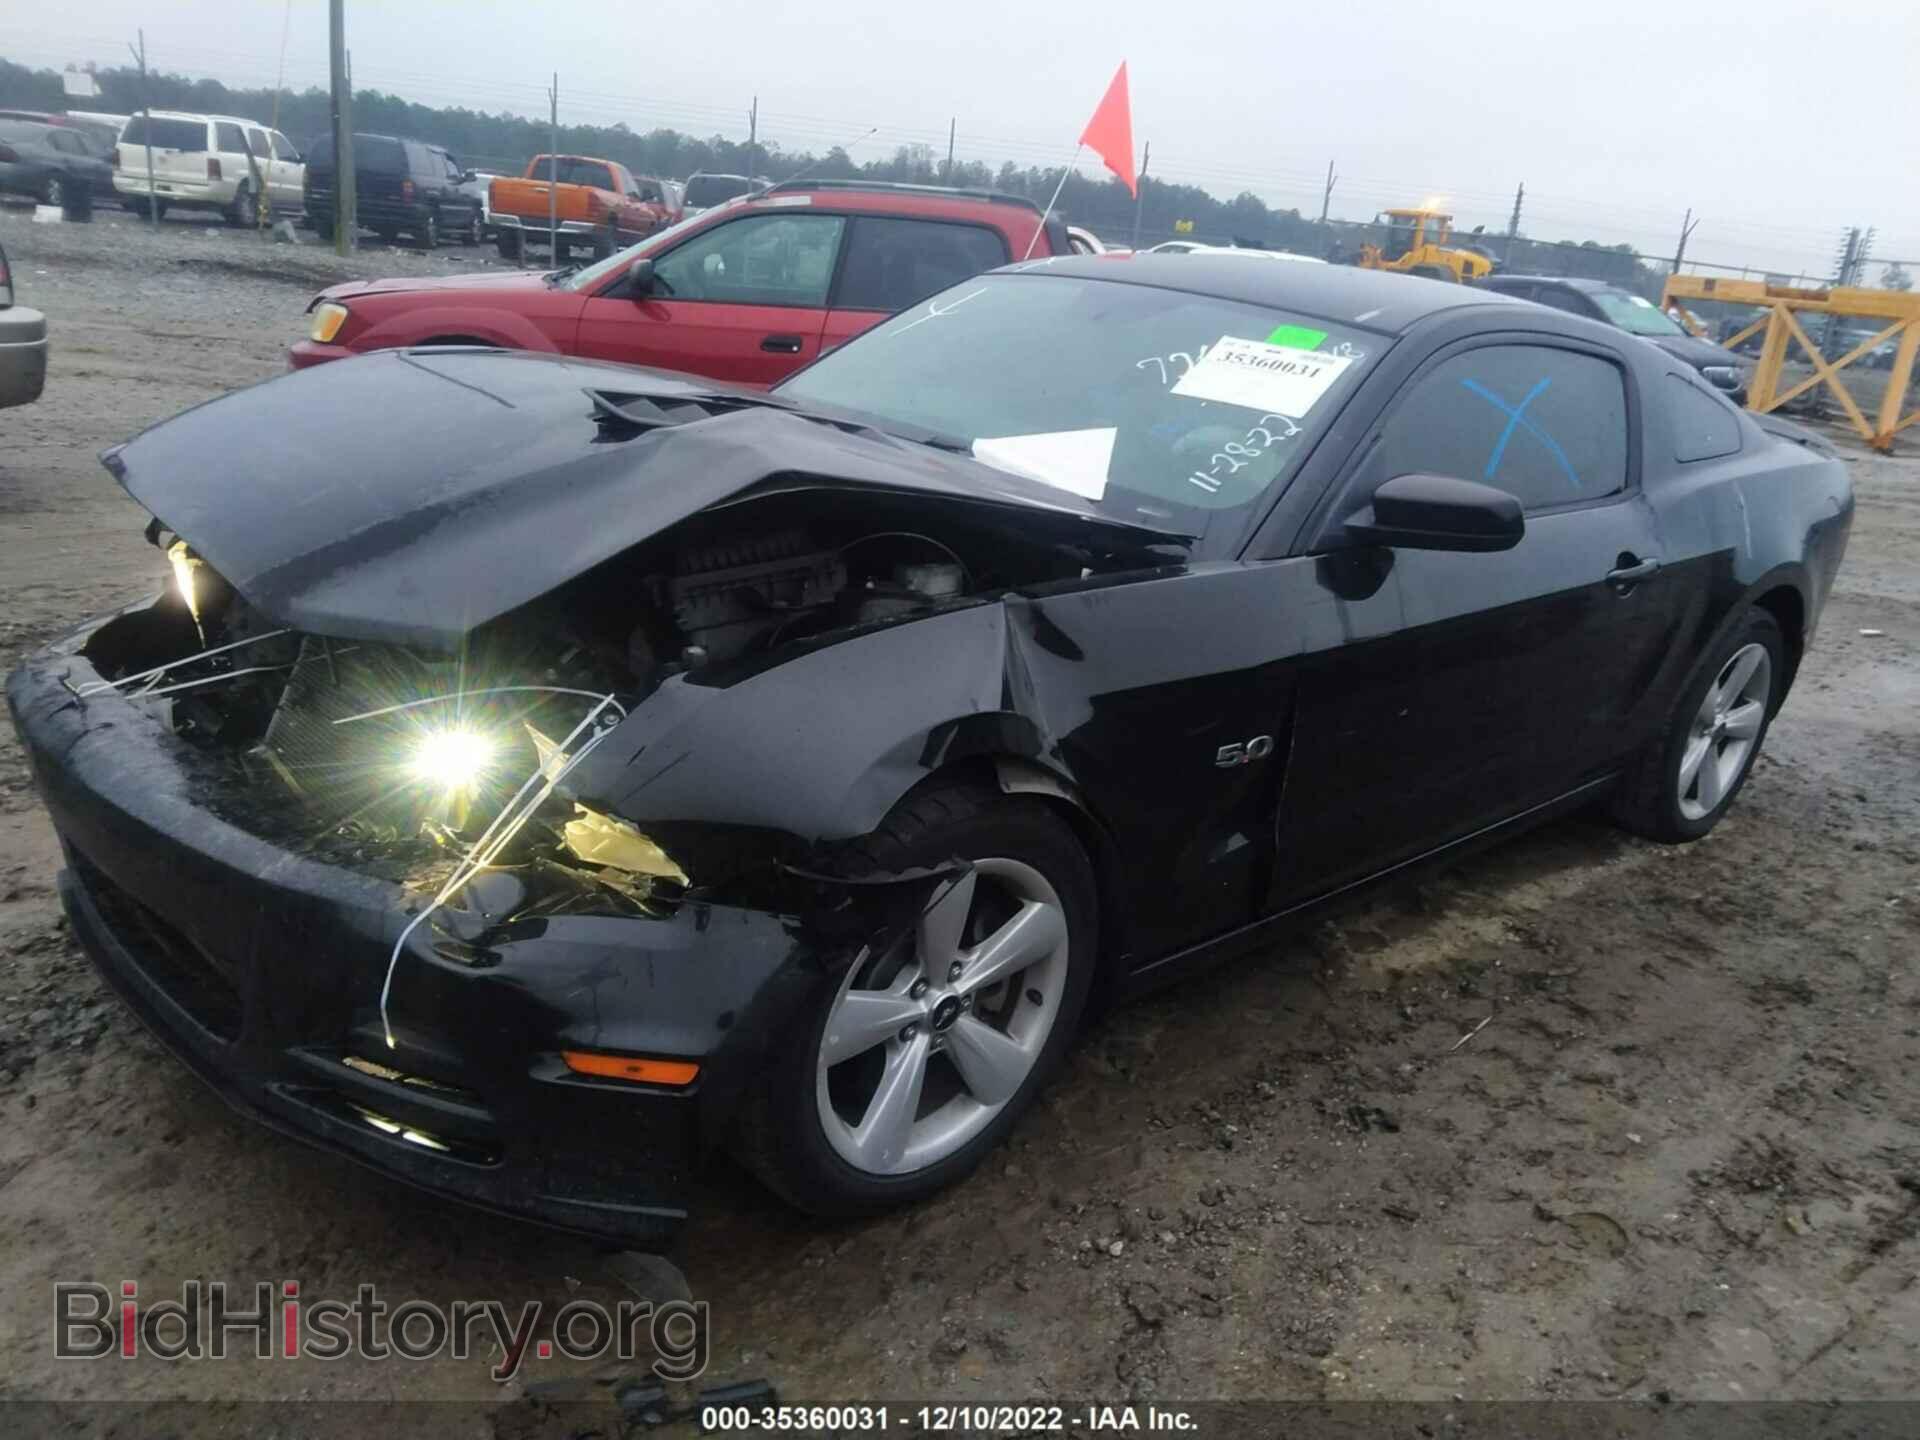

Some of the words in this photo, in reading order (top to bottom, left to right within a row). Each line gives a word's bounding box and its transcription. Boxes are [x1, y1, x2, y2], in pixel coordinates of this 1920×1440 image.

[1217, 351, 1321, 378] 35360031
[1188, 414, 1302, 492] 11-28-22
[1215, 734, 1274, 768] 5.0
